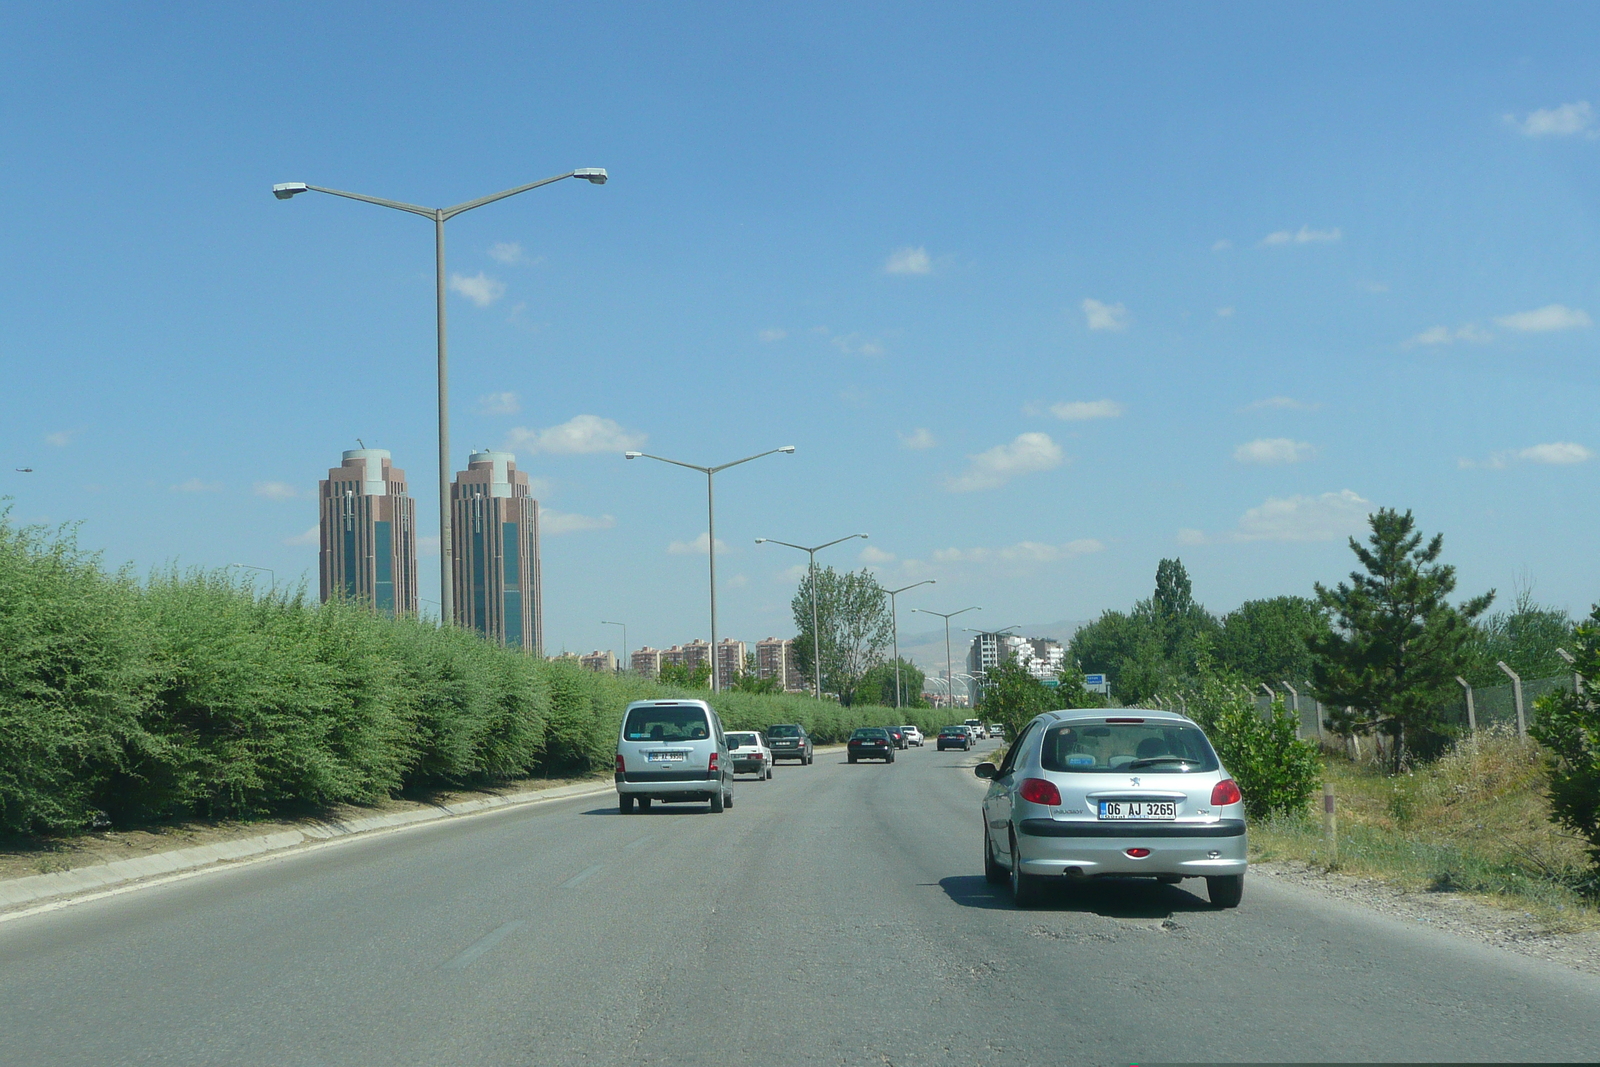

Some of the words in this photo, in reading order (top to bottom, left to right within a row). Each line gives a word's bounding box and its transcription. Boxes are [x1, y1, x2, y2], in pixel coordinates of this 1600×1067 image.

[1107, 803, 1121, 815] 06
[1128, 803, 1142, 815] AJ
[1146, 803, 1173, 816] 3265
